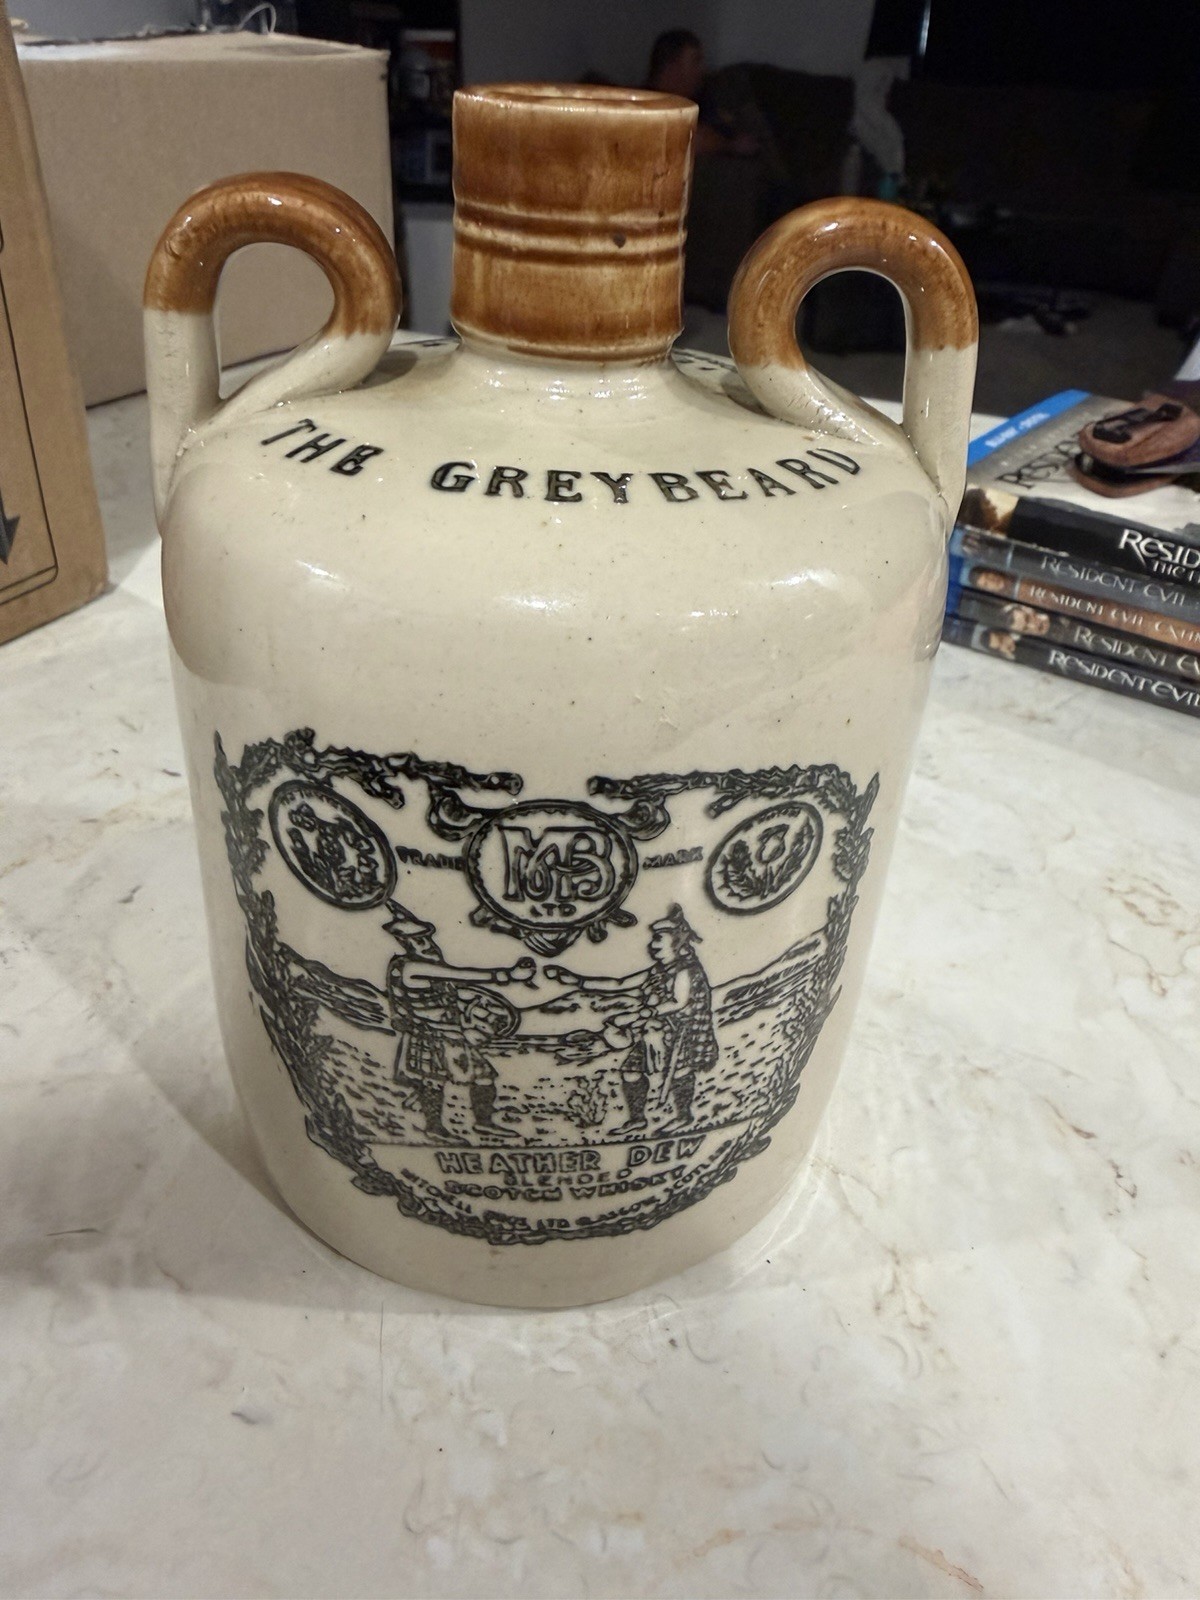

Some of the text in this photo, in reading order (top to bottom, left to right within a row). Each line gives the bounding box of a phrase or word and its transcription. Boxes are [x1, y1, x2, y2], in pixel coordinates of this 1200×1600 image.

[261, 419, 862, 504] THE GREYBEARD
[1040, 556, 1137, 594] RESIDENT
[1030, 585, 1104, 616] RESIDENT
[1073, 624, 1168, 667] RESIDENT
[1048, 649, 1152, 691] RESIDENT
[435, 1134, 707, 1175] HEATHER DEW
